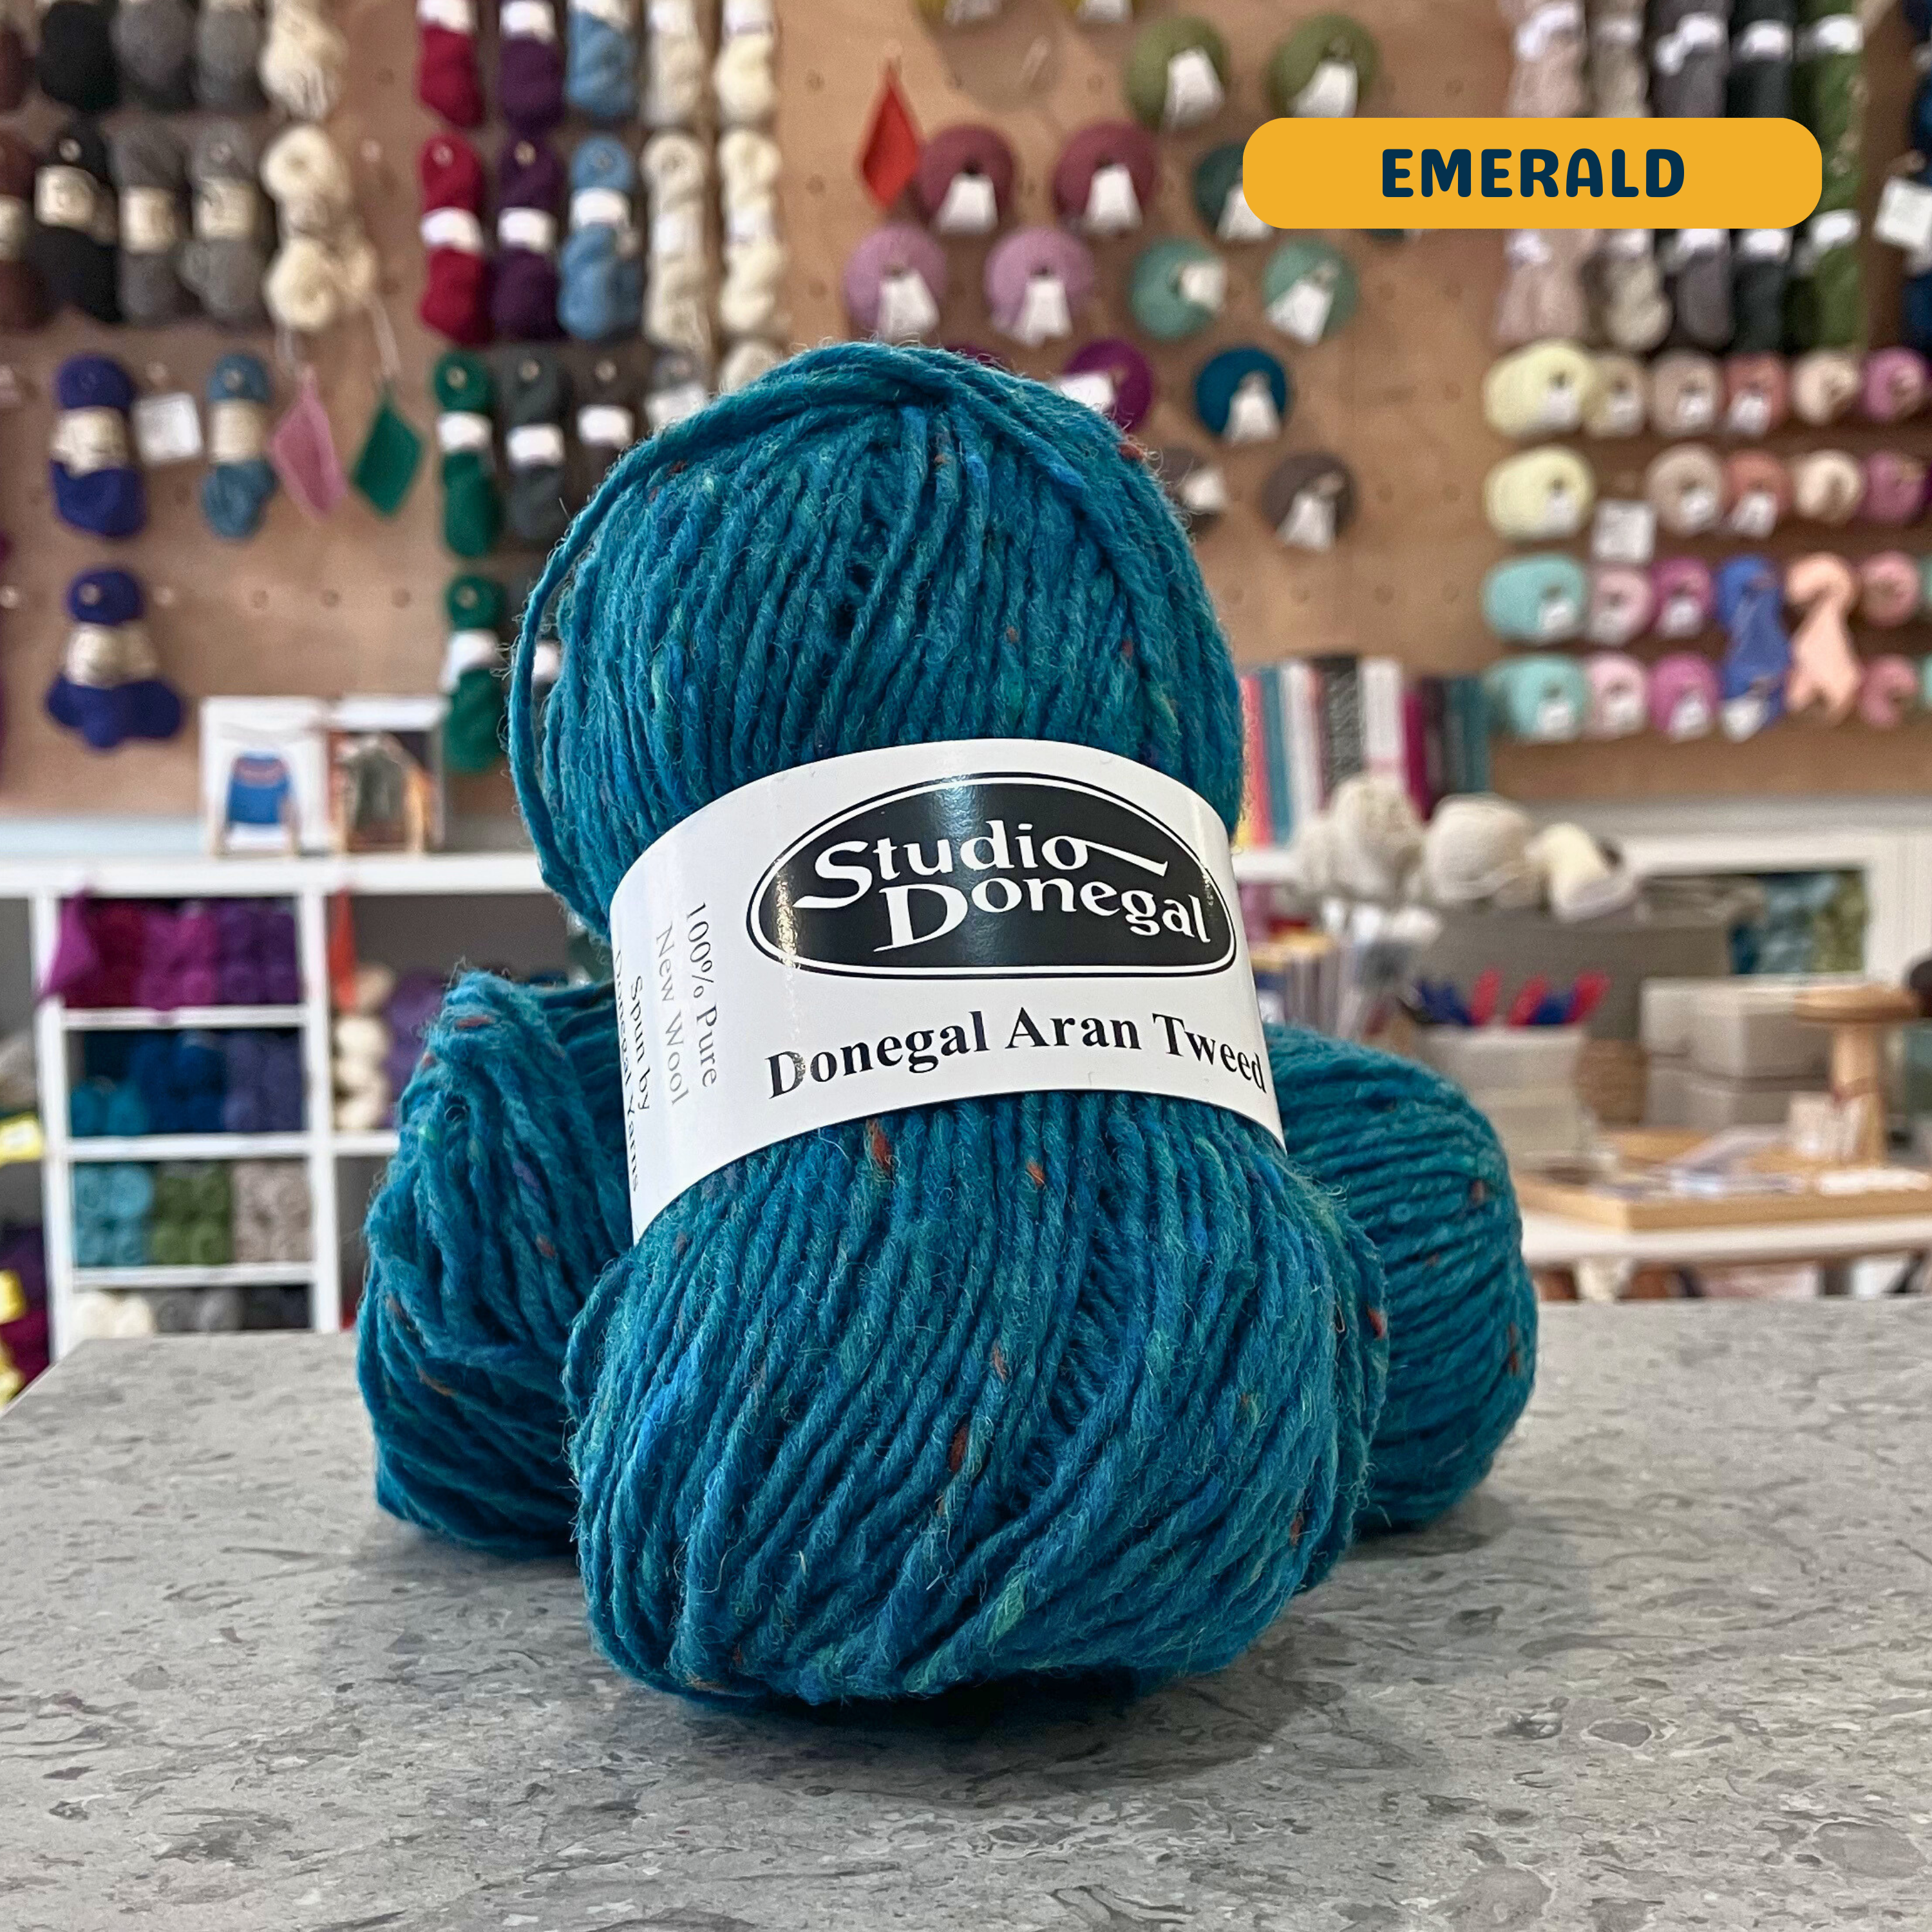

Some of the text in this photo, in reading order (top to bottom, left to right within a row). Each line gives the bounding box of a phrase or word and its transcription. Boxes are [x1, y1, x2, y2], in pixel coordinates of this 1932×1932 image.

[793, 820, 1168, 909] Studio
[873, 876, 1211, 952] Donegal
[630, 975, 651, 1111] Spun by
[656, 923, 690, 1106] New Wool
[686, 902, 718, 1088] 100% Pure
[764, 1006, 1267, 1099] Donegal Aran Tweed
[627, 1092, 639, 1192] Yarns
